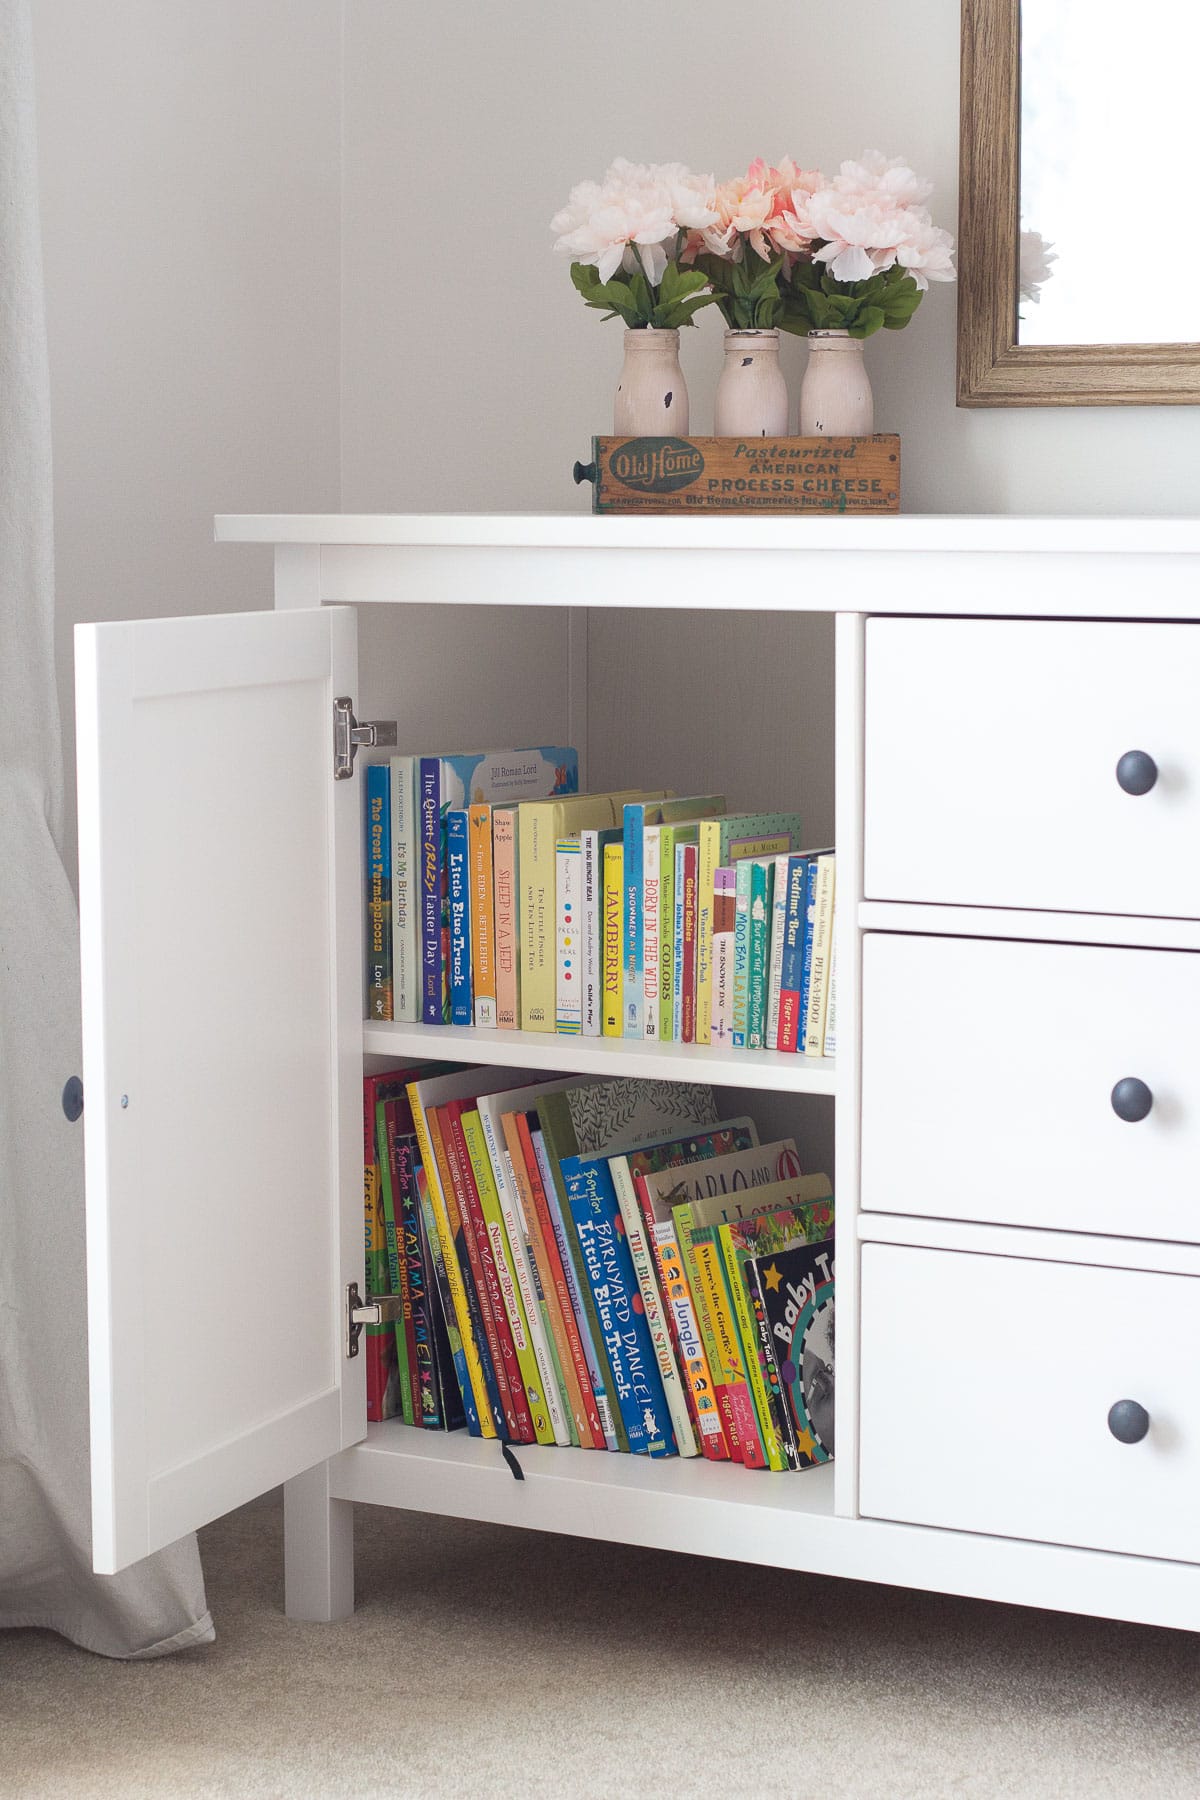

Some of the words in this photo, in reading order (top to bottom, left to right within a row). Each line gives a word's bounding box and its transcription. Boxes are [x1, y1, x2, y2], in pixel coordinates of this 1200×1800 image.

[616, 453, 649, 478] Old
[642, 446, 701, 485] Home
[734, 445, 857, 459] Pasteurized
[748, 463, 840, 474] AMERICAN
[708, 479, 795, 492] PROCESS
[803, 479, 882, 492] CHEESE
[425, 772, 436, 795] The
[502, 766, 522, 776] Roman
[523, 764, 537, 775] Lord
[372, 797, 383, 821] The
[423, 797, 437, 838] Quiet
[495, 818, 511, 826] Shaw
[372, 824, 383, 860] Great
[397, 842, 408, 858] It's
[495, 834, 513, 844] Apple
[585, 836, 594, 849] THE
[396, 861, 408, 878] My
[424, 841, 437, 892] CRAZY
[450, 853, 463, 898] Little
[586, 862, 595, 885] HUNGRY
[821, 867, 829, 887] Janet
[478, 874, 487, 900] EDEN
[497, 869, 513, 908] SHEEP
[537, 887, 546, 904] TEN
[586, 885, 595, 902] BEAR
[644, 879, 659, 913] BORN
[686, 878, 695, 908] Global
[791, 865, 803, 916] Bedtime
[373, 863, 384, 952] Farmapalooza
[398, 880, 409, 929] Birthday
[426, 894, 438, 936] Easter
[452, 902, 464, 935] Blue
[499, 912, 512, 925] IN
[528, 903, 536, 920] TEN
[628, 886, 637, 938] SNOWMEN
[538, 906, 546, 933] LITTLE
[644, 917, 658, 933] IN
[676, 903, 684, 936] Joshua's
[686, 910, 695, 941] Babies
[735, 912, 748, 943] MOO,
[753, 922, 763, 937] BUT
[776, 912, 786, 940] What's
[788, 917, 800, 948] Bear
[479, 914, 489, 973] BETHLEHEM
[498, 929, 511, 939] A
[528, 921, 537, 948] LITTLE
[605, 884, 619, 995] JAMBERRY
[675, 937, 683, 958] Night
[700, 908, 709, 984] Winnie-the-Pooh
[719, 939, 727, 955] THE
[753, 939, 762, 956] NOT
[424, 940, 438, 967] Day
[453, 936, 465, 987] Truck
[499, 942, 512, 973] JEEP
[529, 951, 537, 971] TOES
[538, 935, 546, 968] FINGERS
[644, 937, 658, 962] THE
[735, 944, 747, 976] BAA,
[774, 942, 784, 972] Wrong,
[374, 965, 384, 989] Lord
[662, 943, 671, 1000] COLORS
[674, 959, 682, 996] Whispers
[719, 956, 727, 991] SNOWY
[752, 958, 762, 972] THE
[427, 975, 436, 996] Lord
[586, 984, 594, 1007] Child's
[644, 967, 658, 999] WILD
[734, 975, 747, 993] LA
[773, 974, 782, 999] Little
[810, 957, 825, 1024] PEEK-A-BOO!
[719, 992, 727, 1008] DAY
[733, 995, 746, 1009] LA
[785, 997, 795, 1021] tiger
[498, 1016, 514, 1024] HMH
[529, 1013, 546, 1021] HMH
[586, 1009, 594, 1025] Play
[733, 1011, 746, 1031] LA!
[783, 1022, 793, 1046] tales
[388, 1121, 397, 1175] Wilson/Chapman
[466, 1127, 478, 1157] Peter
[473, 1160, 491, 1197] Rabbit
[396, 1145, 413, 1190] Boynton
[452, 1120, 467, 1163] WILLIAMS
[465, 1171, 478, 1209] MASSINI
[494, 1162, 505, 1190] JERAM
[750, 1166, 771, 1188] AND
[364, 1167, 375, 1213] first
[583, 1168, 604, 1214] Boynton
[385, 1221, 395, 1248] Bear
[504, 1210, 516, 1233] WILL
[643, 1211, 655, 1232] ARLO
[681, 1221, 696, 1245] LOVE
[396, 1227, 406, 1255] Bear
[440, 1235, 449, 1251] THE
[511, 1235, 522, 1256] YOU
[403, 1212, 425, 1301] PAJAMA
[515, 1257, 525, 1269] BE
[554, 1223, 567, 1257] BABY
[562, 1258, 582, 1316] BEDTIME
[388, 1252, 399, 1290] Wants
[399, 1258, 411, 1300] Snores
[444, 1253, 460, 1298] HONEYBEE
[518, 1271, 529, 1285] MY
[489, 1225, 508, 1274] Nursery
[502, 1275, 517, 1317] Rhyme
[511, 1316, 526, 1349] Time
[403, 1302, 412, 1319] On
[479, 1292, 492, 1322] HARTMAN
[522, 1286, 538, 1327] FRIEND?
[577, 1220, 602, 1281] Little
[594, 1284, 613, 1331] Blue
[605, 1331, 630, 1401] Truck
[595, 1220, 630, 1322] BARNYARD
[621, 1328, 653, 1405] DANCE!
[630, 1229, 646, 1262] THE
[638, 1265, 662, 1330] BIGGEST
[653, 1331, 675, 1381] STORY
[701, 1247, 717, 1291] Where's
[711, 1292, 720, 1310] the
[716, 1310, 733, 1356] Giraffe?
[773, 1272, 818, 1346] Baby
[412, 1306, 432, 1365] TIME!
[675, 1300, 700, 1357] Jungle
[758, 1320, 769, 1344] Baby
[537, 1347, 550, 1386] CANDLEWICK
[763, 1343, 775, 1363] Talk
[721, 1394, 733, 1421] tiger
[727, 1421, 740, 1447] tales
